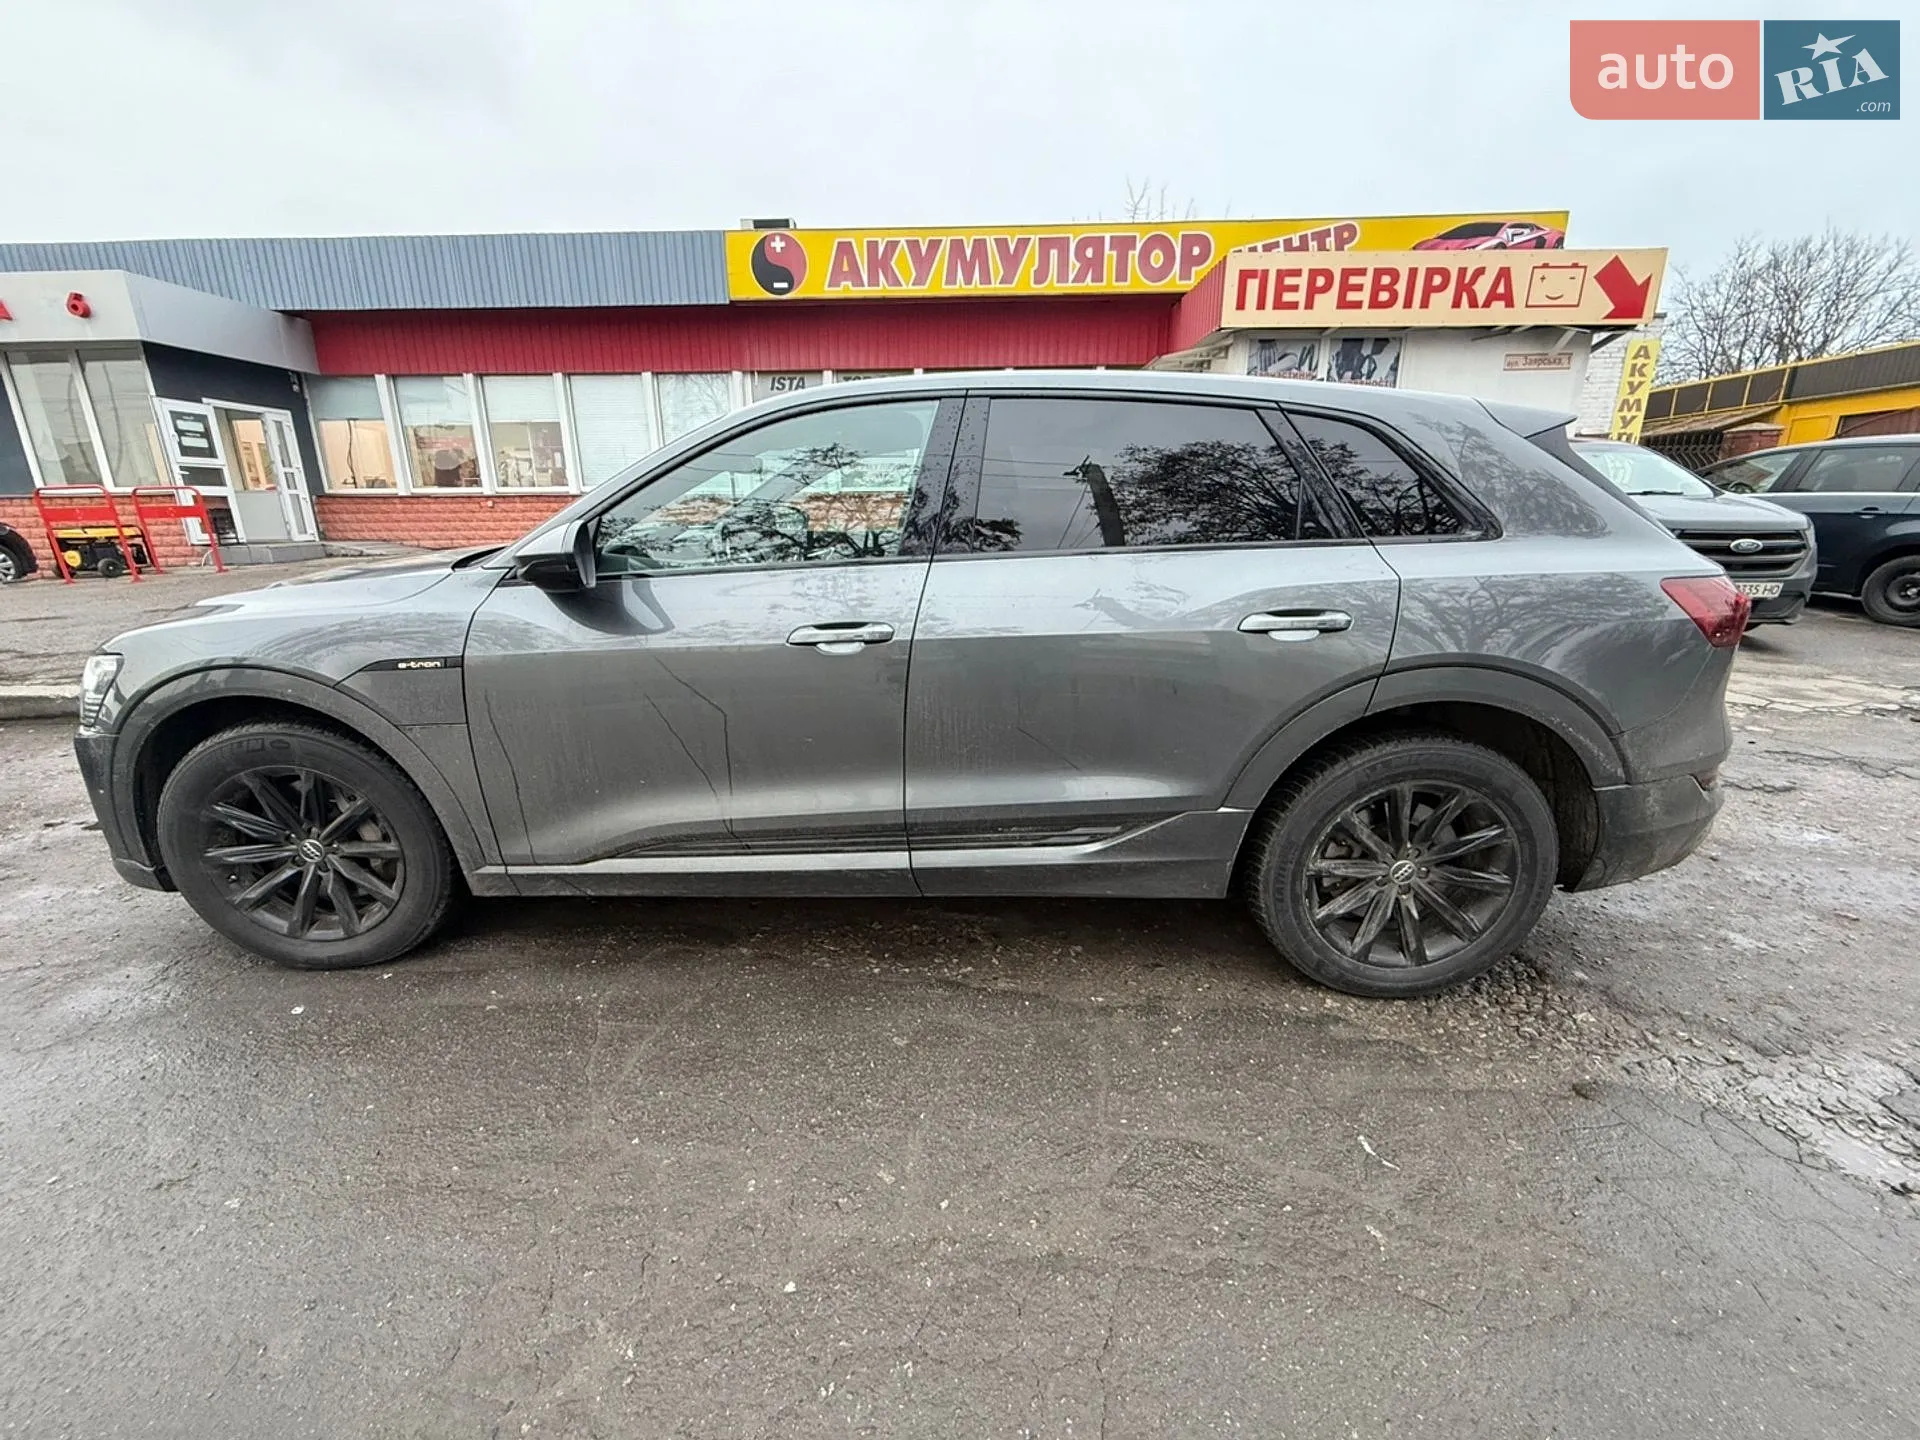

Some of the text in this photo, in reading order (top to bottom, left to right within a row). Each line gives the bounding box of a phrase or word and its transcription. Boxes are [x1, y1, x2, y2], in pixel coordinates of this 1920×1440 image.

[825, 232, 1213, 289] АКУМУЛЯТОР
[1235, 266, 1515, 311] ПЕРЕВІРКА
[770, 376, 806, 391] ISTA
